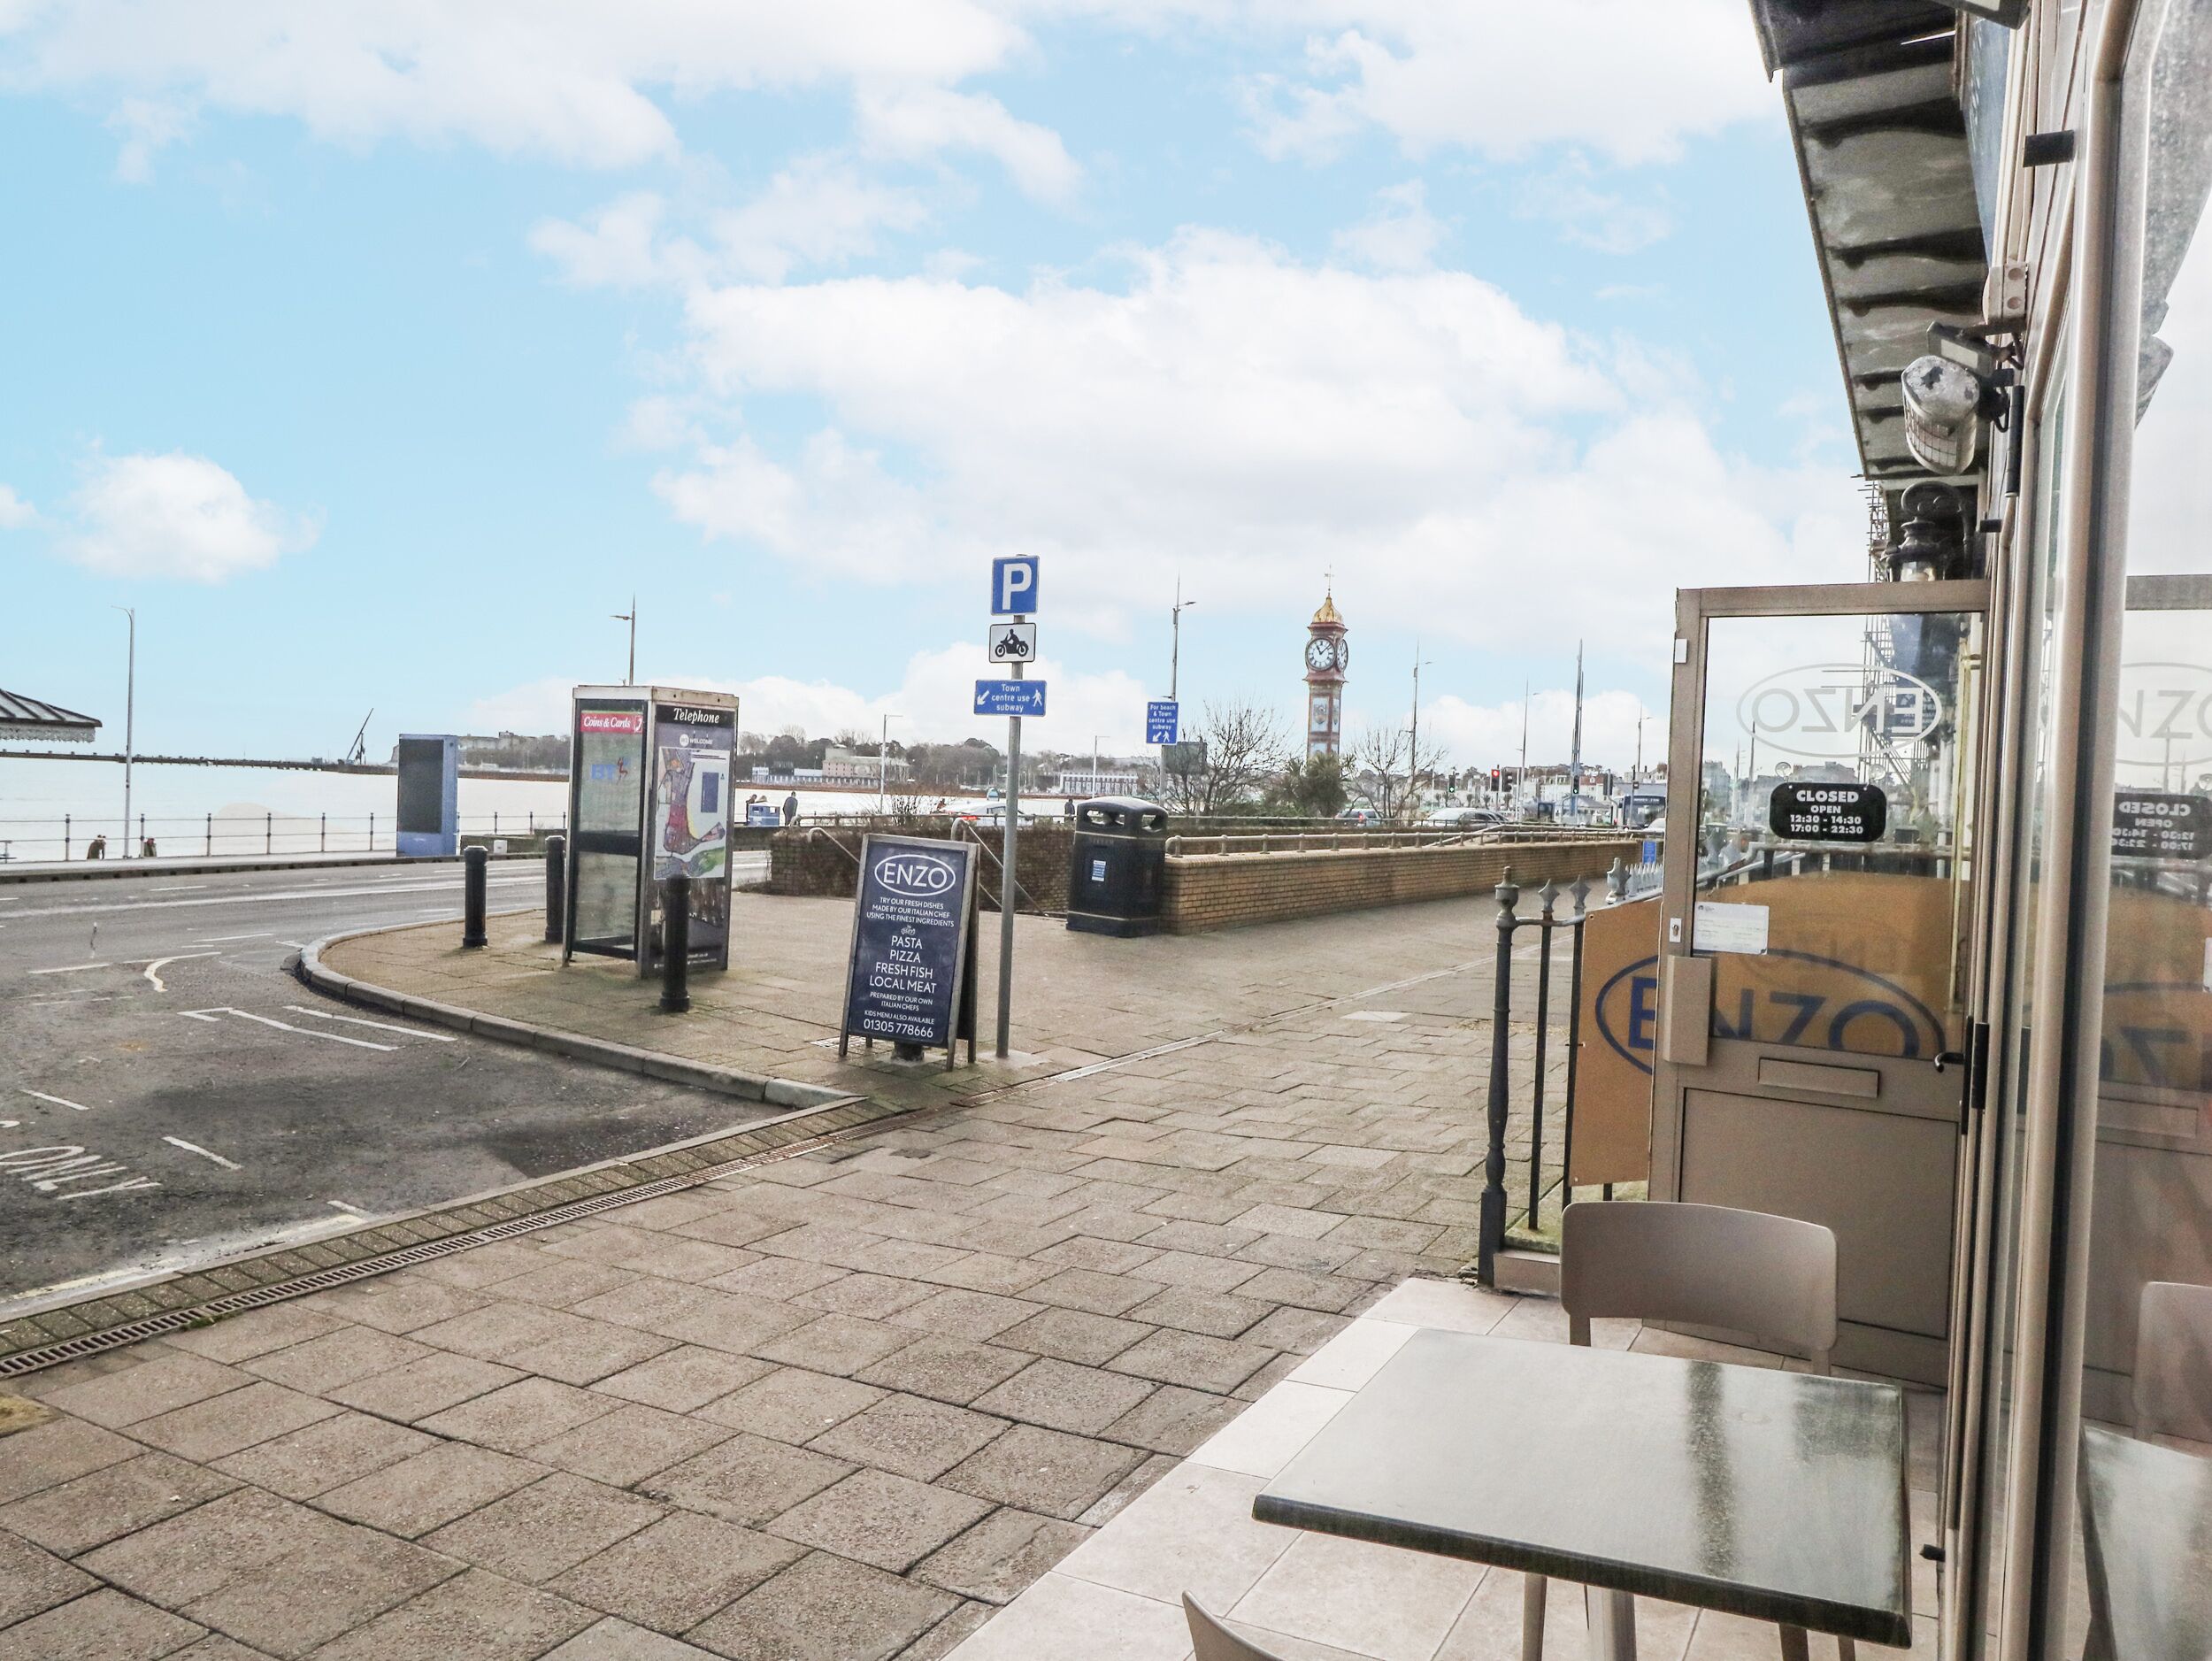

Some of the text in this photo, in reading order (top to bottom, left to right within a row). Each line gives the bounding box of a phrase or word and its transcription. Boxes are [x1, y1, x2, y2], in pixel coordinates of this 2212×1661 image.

[1002, 563, 1032, 610] P
[996, 704, 1024, 713] subway
[584, 716, 632, 728] Coins & Cards
[673, 707, 720, 724] Telephone
[1796, 789, 1860, 804] CLOSED
[1810, 804, 1841, 814] OPEN
[1790, 814, 1820, 823] 12:30
[1831, 815, 1862, 825] 14:30
[1790, 824, 1820, 833] 17:00
[1831, 825, 1863, 834] 22:30
[883, 862, 948, 888] ENZO
[904, 899, 923, 908] FRESH
[911, 908, 933, 917] ITALIAN
[916, 917, 955, 927] INGREDIENTS
[891, 935, 923, 950] PASTA
[889, 950, 921, 964] PIZZA
[875, 962, 933, 980] FRESH FISH
[869, 974, 937, 994] LOCAL MEAT
[870, 991, 897, 1001] PREPARED
[904, 996, 918, 1004] OUR
[907, 1016, 934, 1025] AVAILABLE
[864, 1018, 933, 1038] 01305 778666
